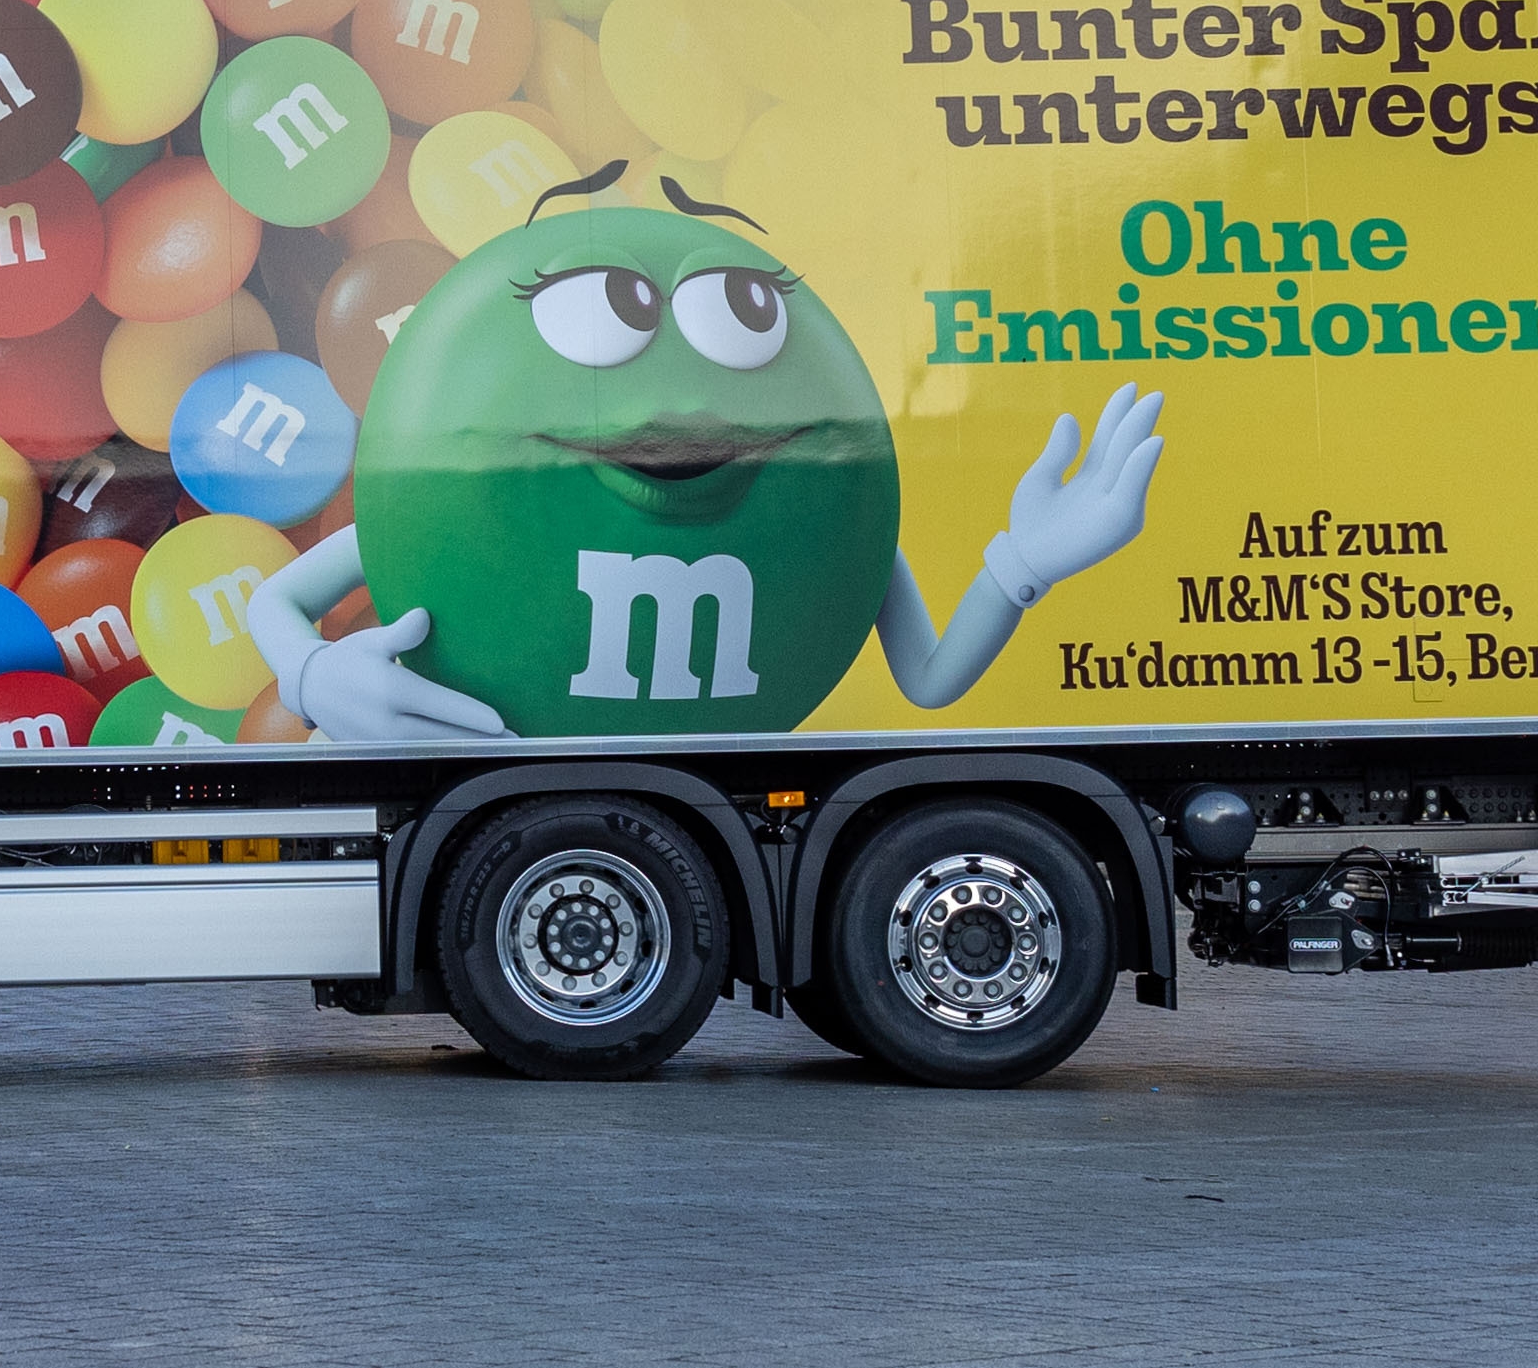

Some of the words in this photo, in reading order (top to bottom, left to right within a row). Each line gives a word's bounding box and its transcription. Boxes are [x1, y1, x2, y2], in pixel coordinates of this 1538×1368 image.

[1120, 198, 1408, 277] Ohne
[1238, 509, 1332, 559] Auf
[1336, 518, 1449, 557] zum
[569, 548, 760, 700] m
[1361, 571, 1514, 624] Store,
[644, 831, 713, 949] MICHELIN
